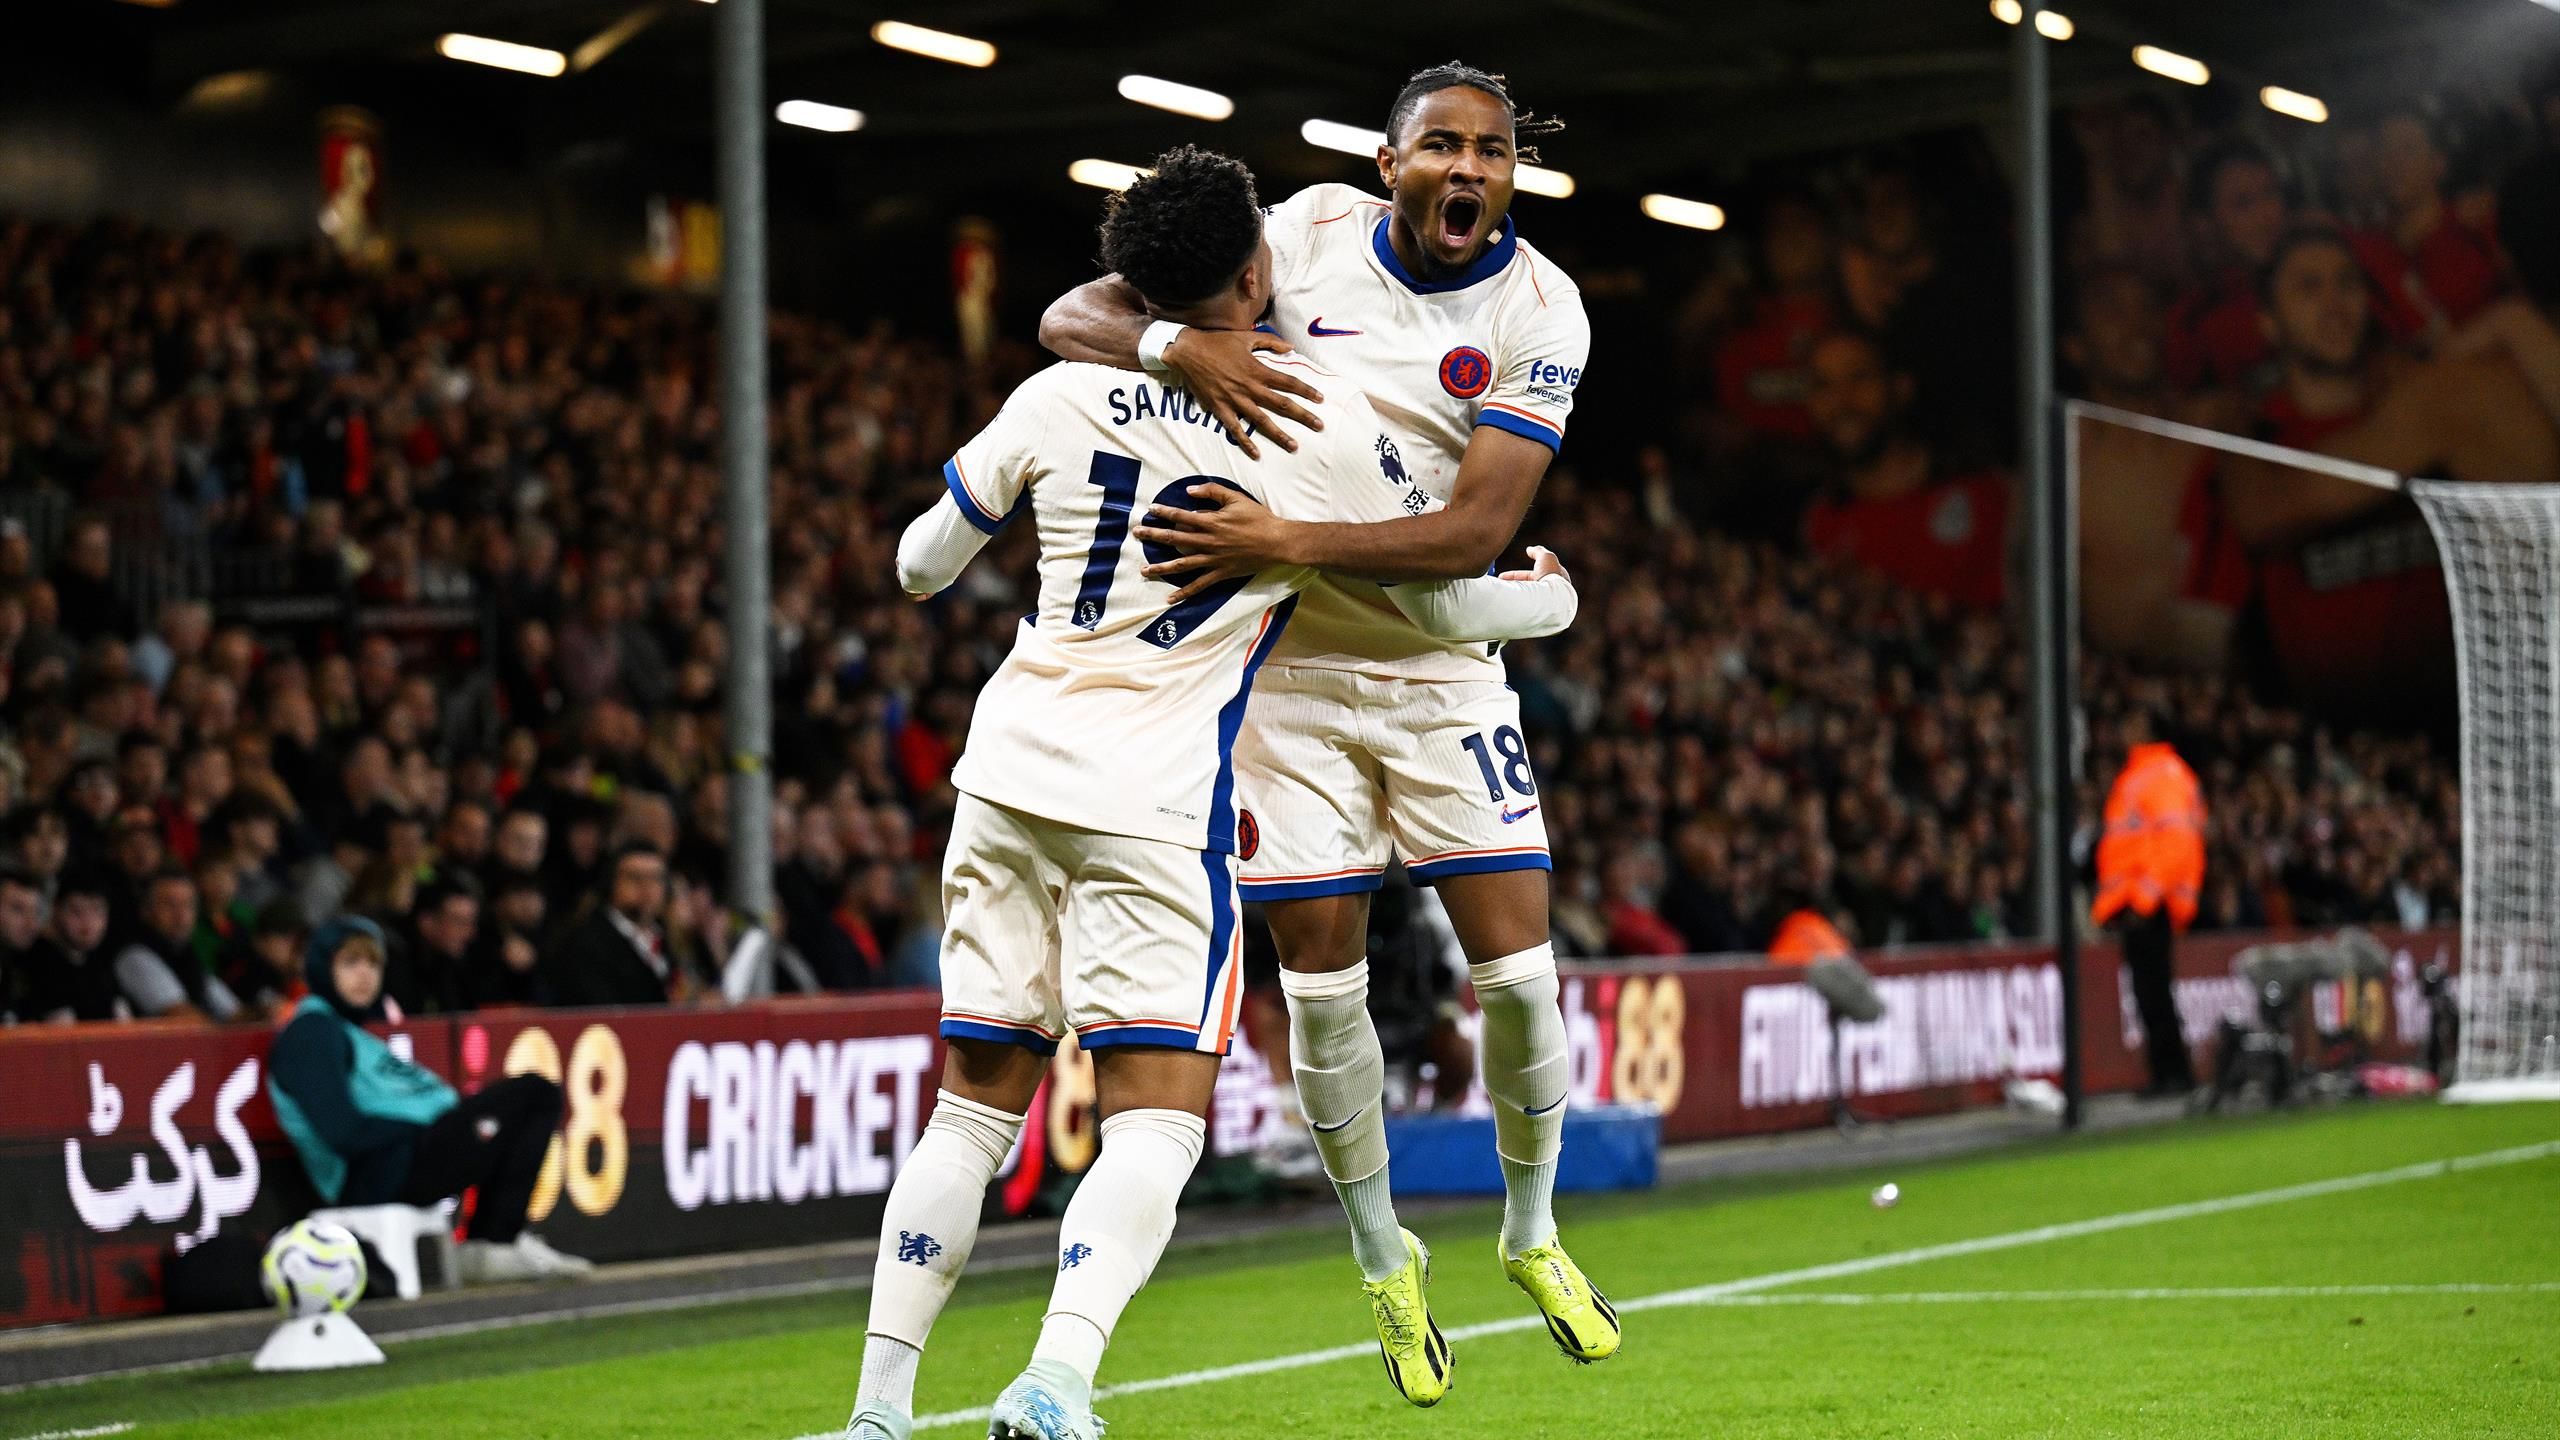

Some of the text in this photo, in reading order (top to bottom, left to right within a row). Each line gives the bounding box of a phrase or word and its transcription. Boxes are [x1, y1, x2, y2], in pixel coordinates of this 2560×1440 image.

[1071, 450, 1262, 650] 19
[1460, 725, 1535, 802] 18
[662, 1034, 933, 1212] CRICKET
